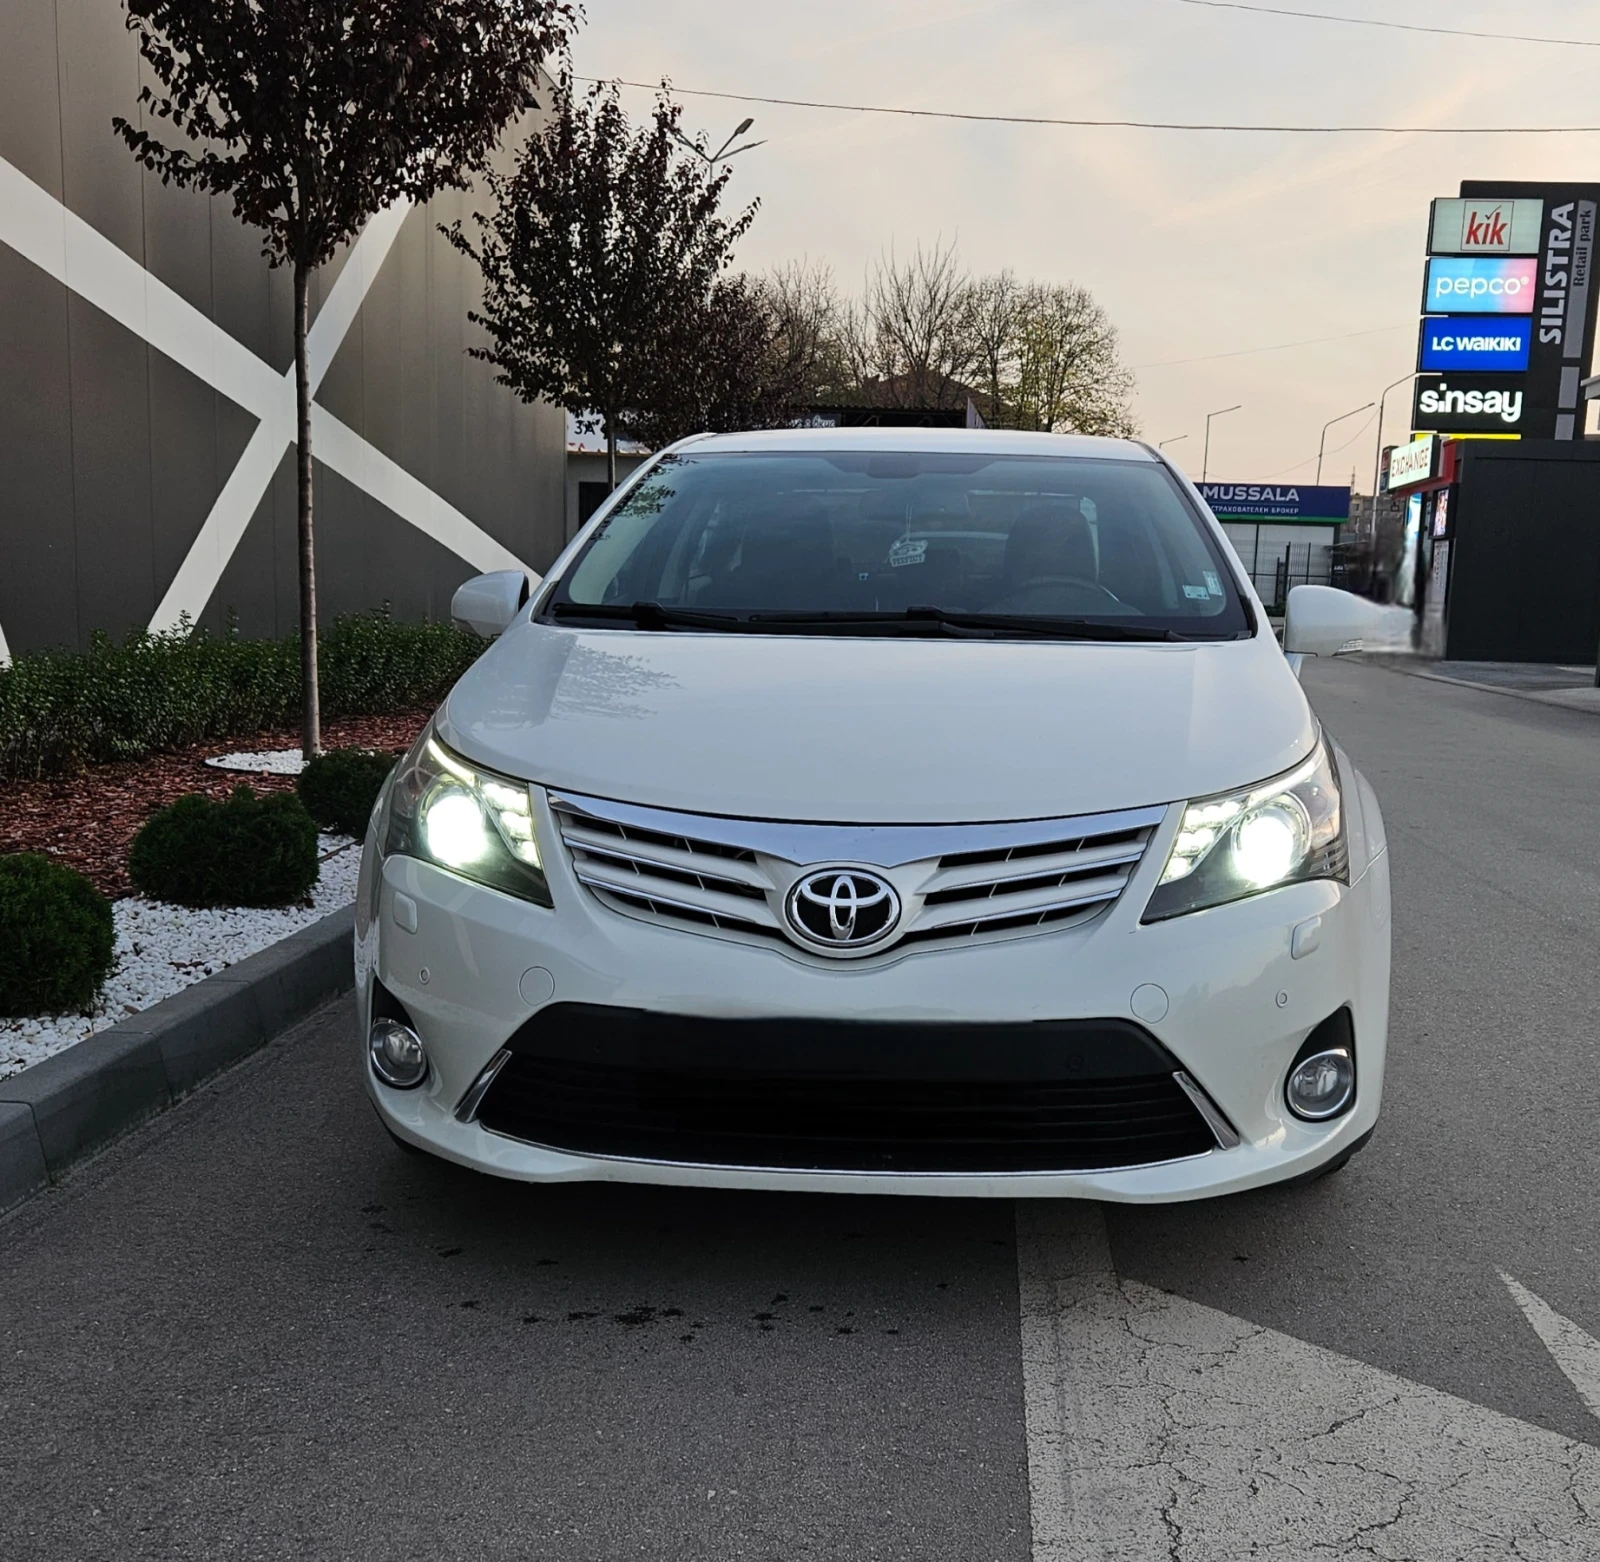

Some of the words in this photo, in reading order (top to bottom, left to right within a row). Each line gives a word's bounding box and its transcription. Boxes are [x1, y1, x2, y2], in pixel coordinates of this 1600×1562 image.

[1465, 205, 1508, 245] kik
[1580, 209, 1592, 242] park
[1539, 202, 1575, 344] SILISTRA
[1573, 246, 1588, 287] Retail
[1432, 336, 1455, 351] LC
[1419, 383, 1523, 422] sinsay
[1391, 446, 1430, 477] EXCHANGE
[1202, 486, 1300, 502] MUSSALA
[1211, 505, 1269, 514] СТРАХОВАТЕЛЕН
